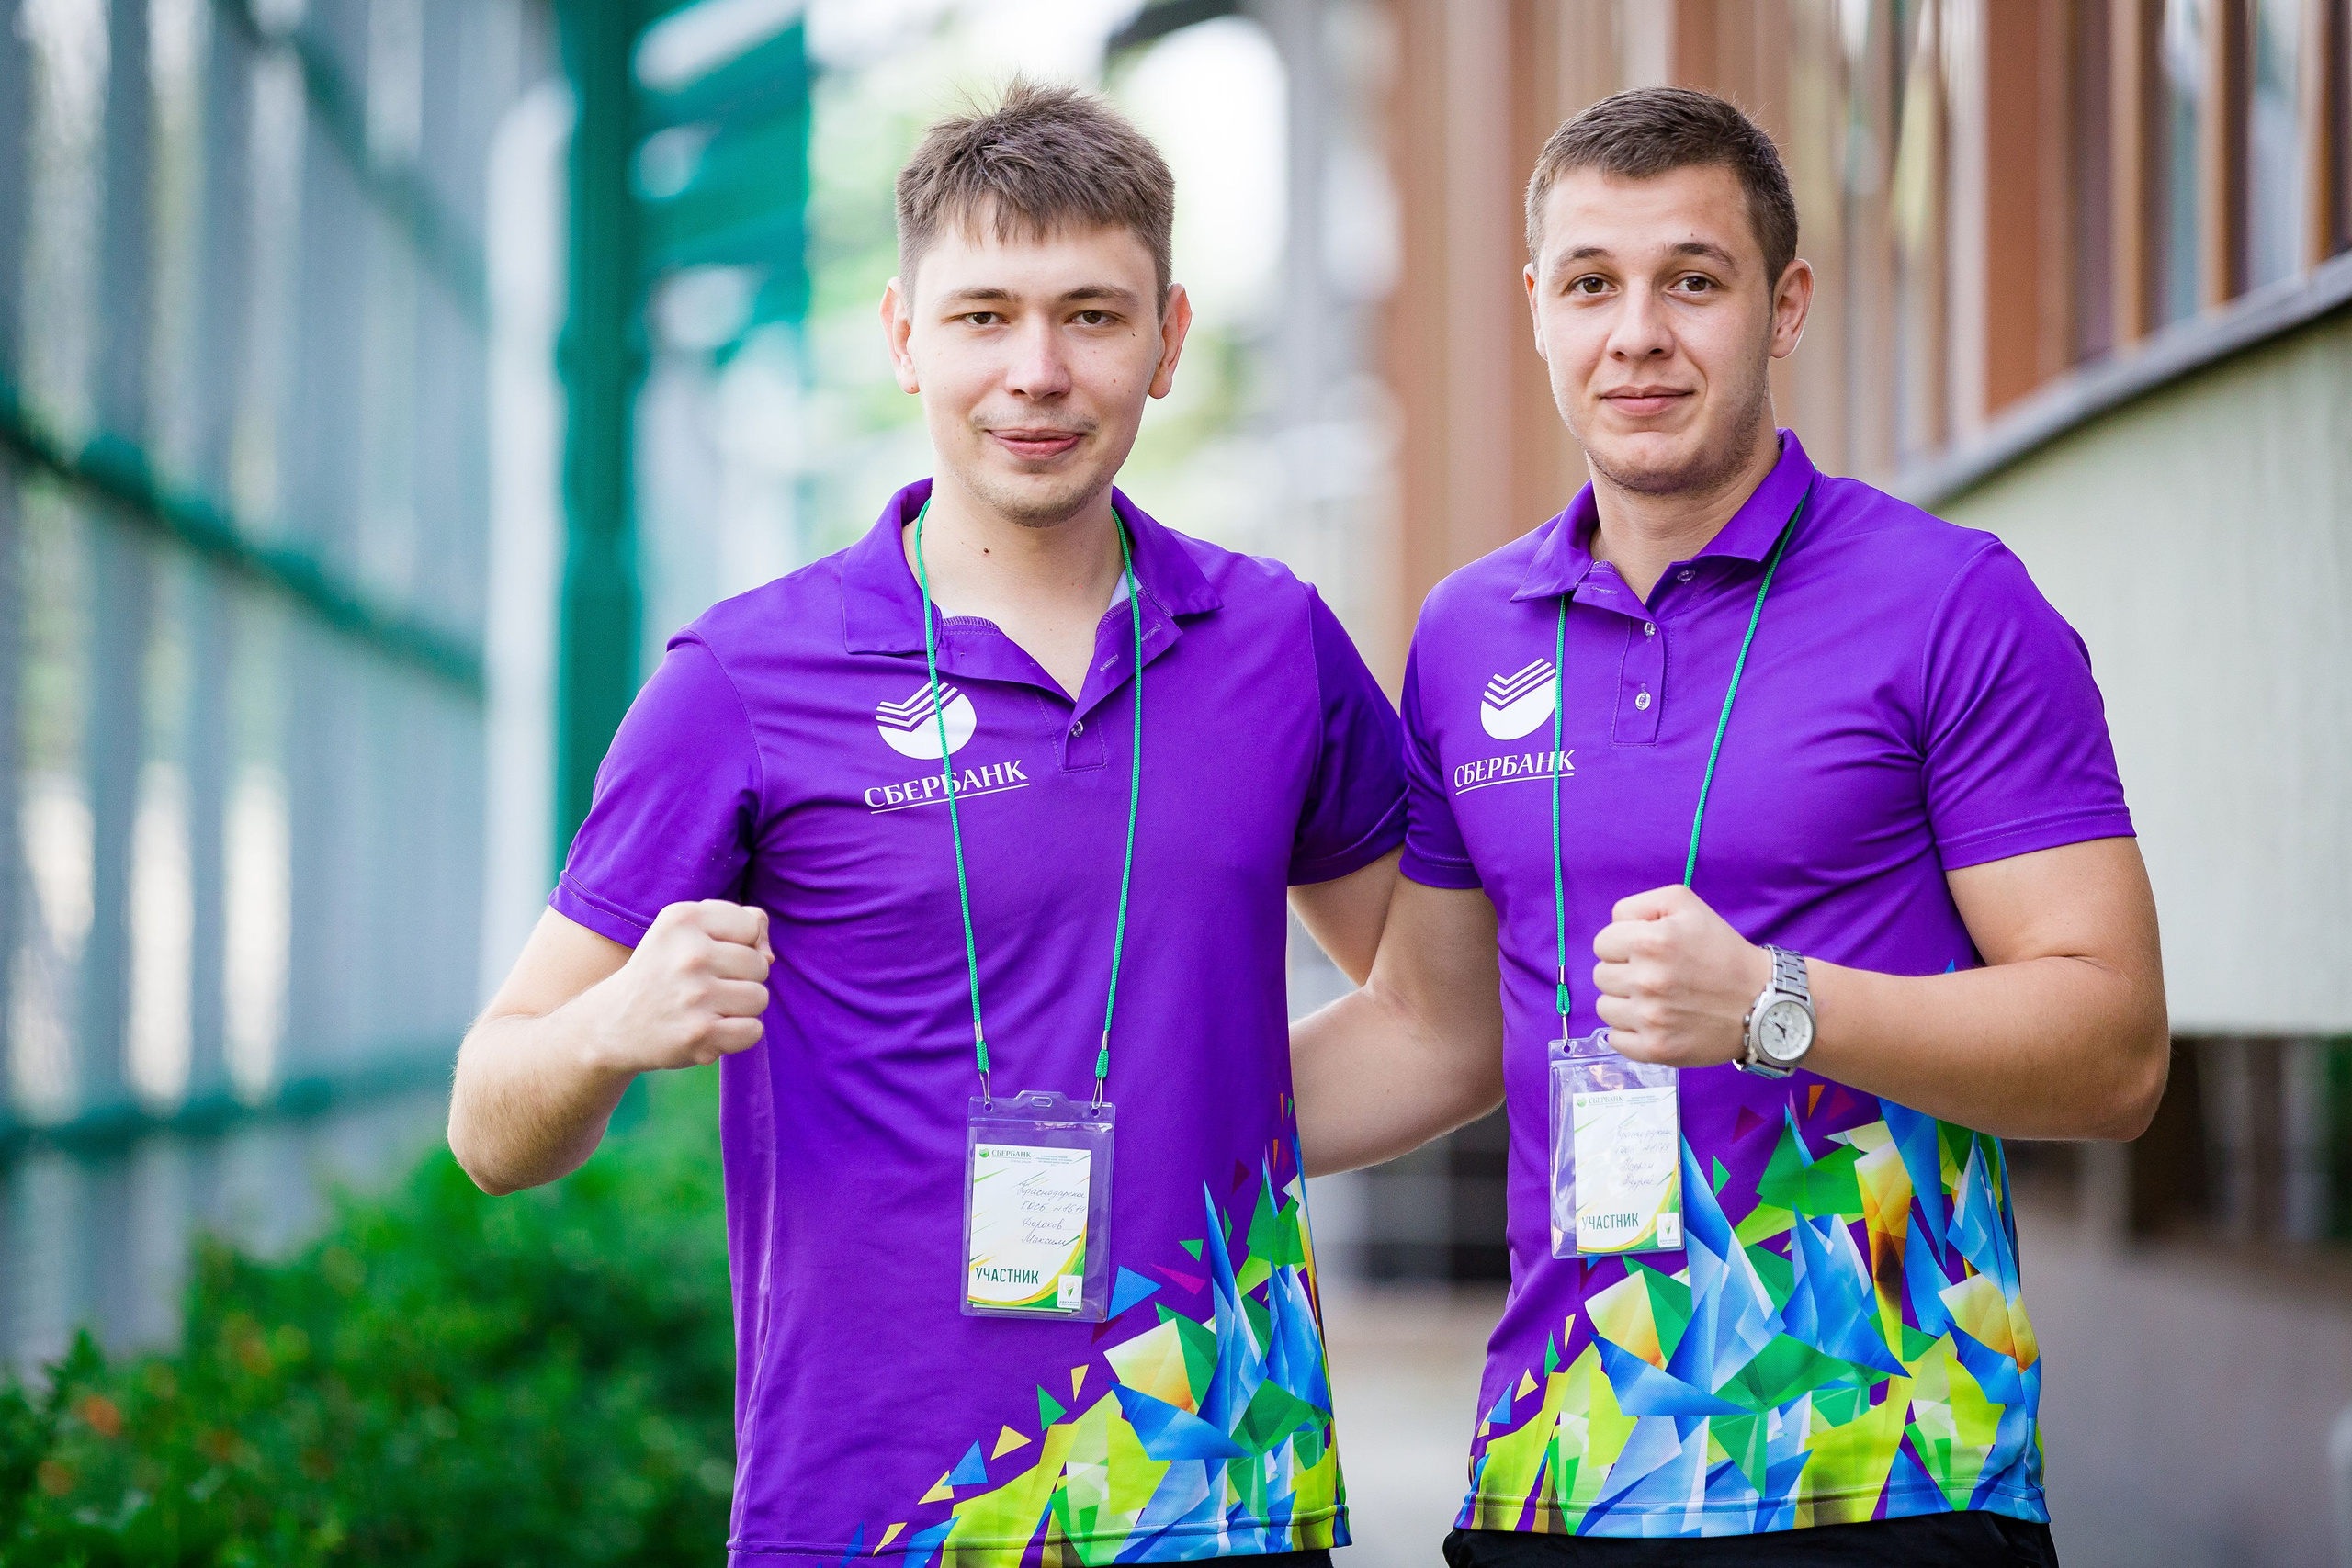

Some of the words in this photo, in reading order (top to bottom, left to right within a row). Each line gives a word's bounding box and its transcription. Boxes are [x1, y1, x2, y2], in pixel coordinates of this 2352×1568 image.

[1453, 750, 1576, 788] СБЕРБАНК
[864, 760, 1028, 807] СБЕРБАНК
[991, 1149, 1032, 1158] СБЕРБАНК
[1581, 1213, 1639, 1231] УЧАСТНИК
[975, 1267, 1039, 1284] УЧАСТНИК
